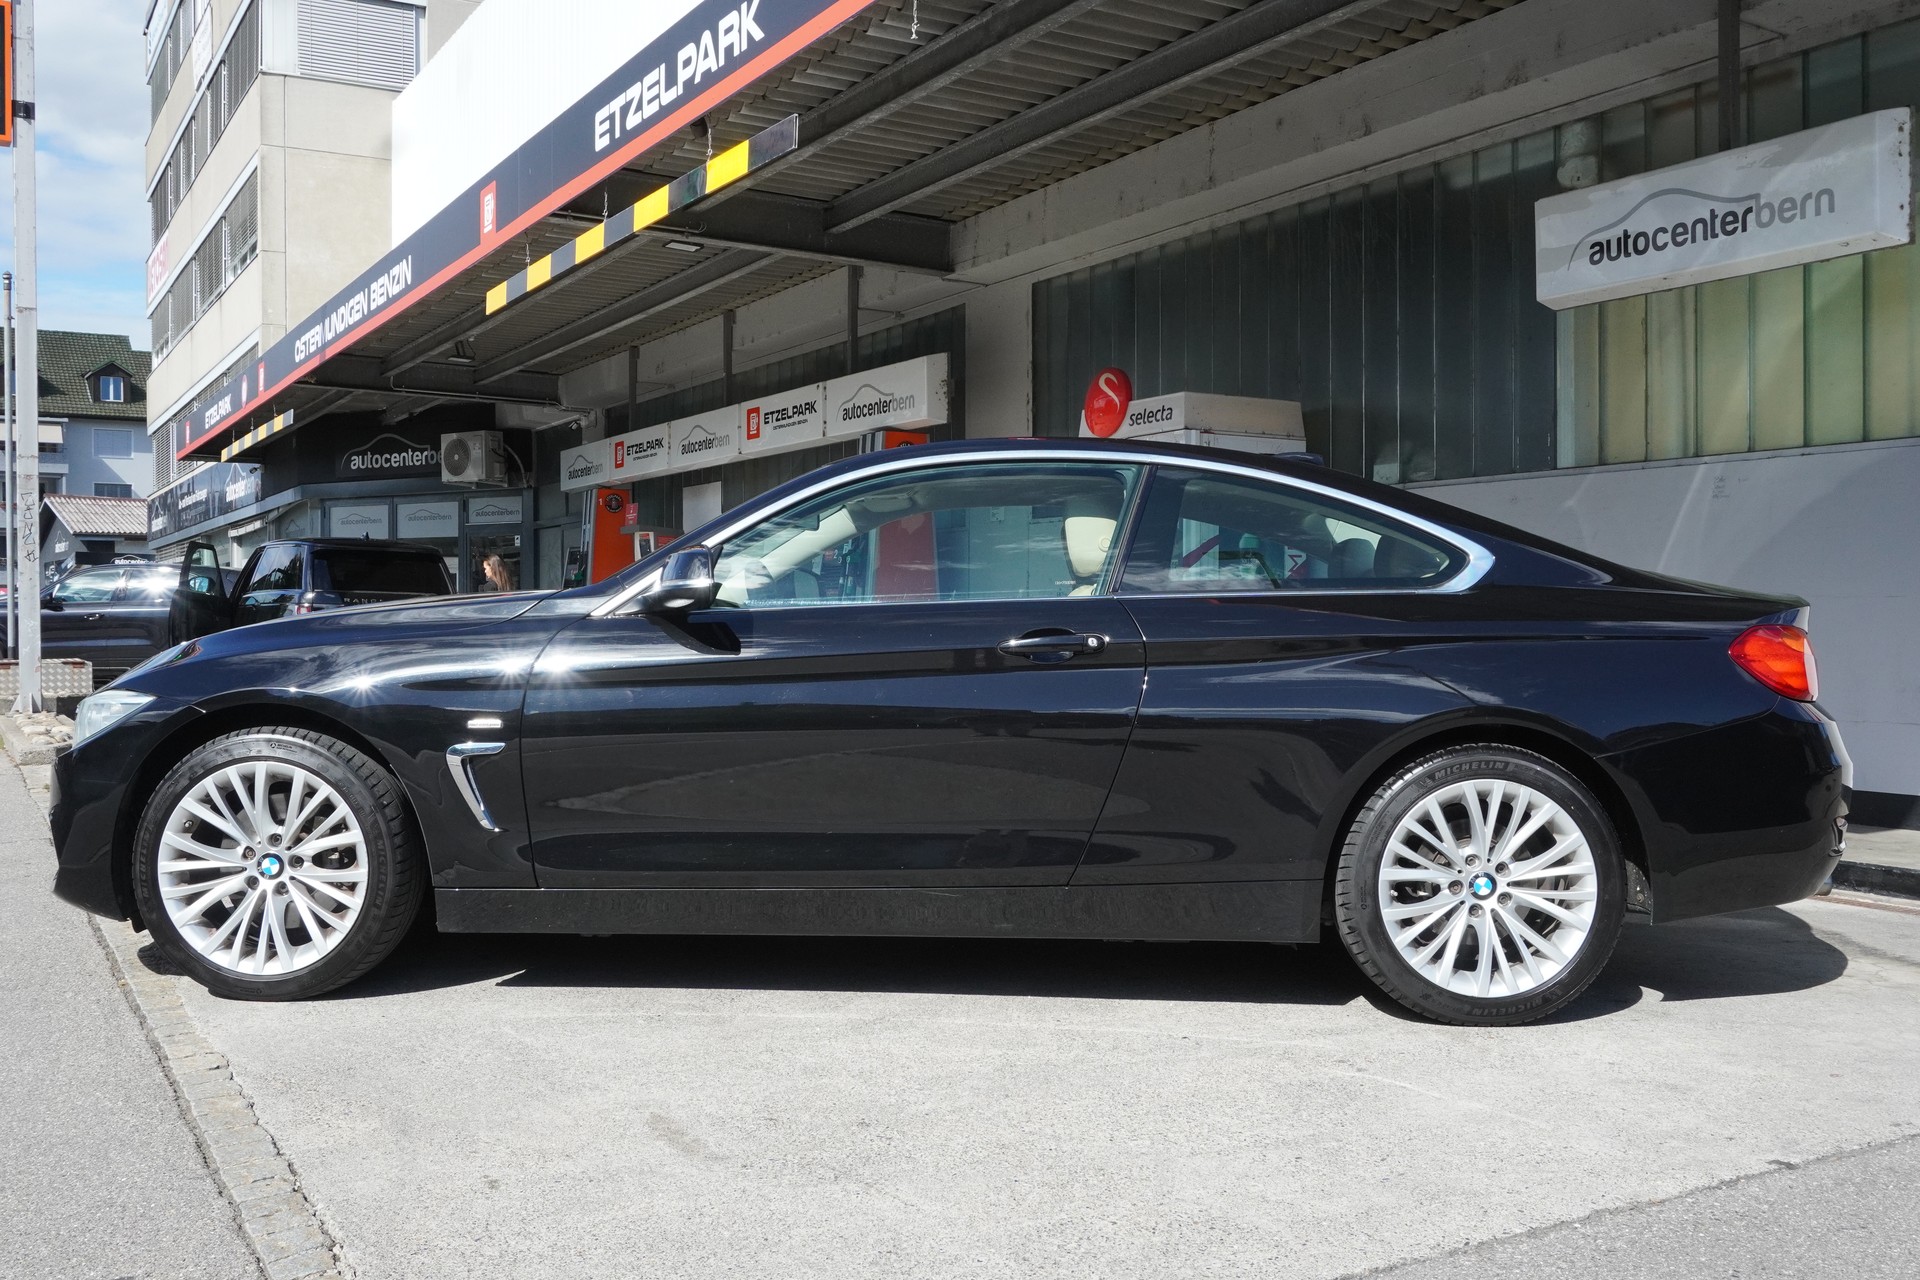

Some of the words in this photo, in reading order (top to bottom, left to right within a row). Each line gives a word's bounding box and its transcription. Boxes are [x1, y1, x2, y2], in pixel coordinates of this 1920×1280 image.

[595, 0, 765, 152] ETZELPARK
[1588, 188, 1836, 266] autocenterbern
[295, 287, 368, 363] OSTERMUNDIGEN
[370, 255, 412, 311] BENZIN
[763, 400, 817, 425] ETZELPARK
[842, 394, 915, 422] autocenterbern
[1128, 405, 1173, 427] selecta
[626, 437, 664, 456] ETZELPARK
[681, 434, 730, 455] autocenterbern
[350, 448, 441, 470] autocenterb
[407, 512, 452, 522] autocenterbern
[475, 507, 520, 517] autocenterbern
[1435, 761, 1506, 780] MICHELIN
